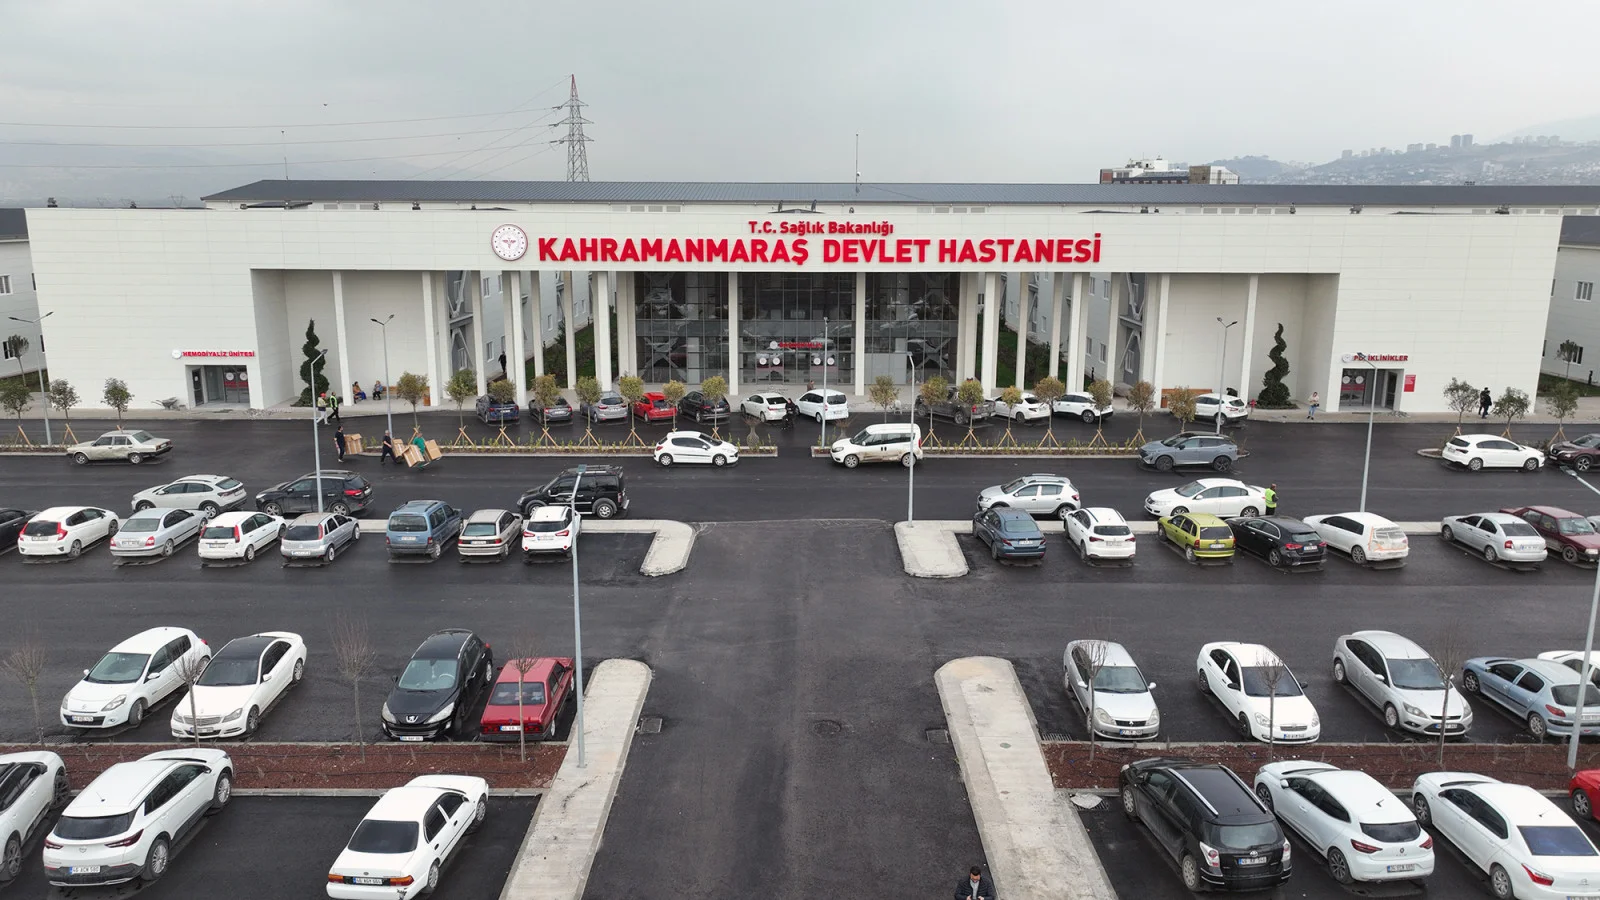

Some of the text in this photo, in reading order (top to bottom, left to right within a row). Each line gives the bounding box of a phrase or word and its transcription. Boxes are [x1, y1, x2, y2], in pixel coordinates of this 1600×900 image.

[748, 221, 894, 236] T.C. Sağlık Bakanlığı
[538, 233, 1101, 265] KAHRAMANMARAŞ DEVLET HASTANESİ
